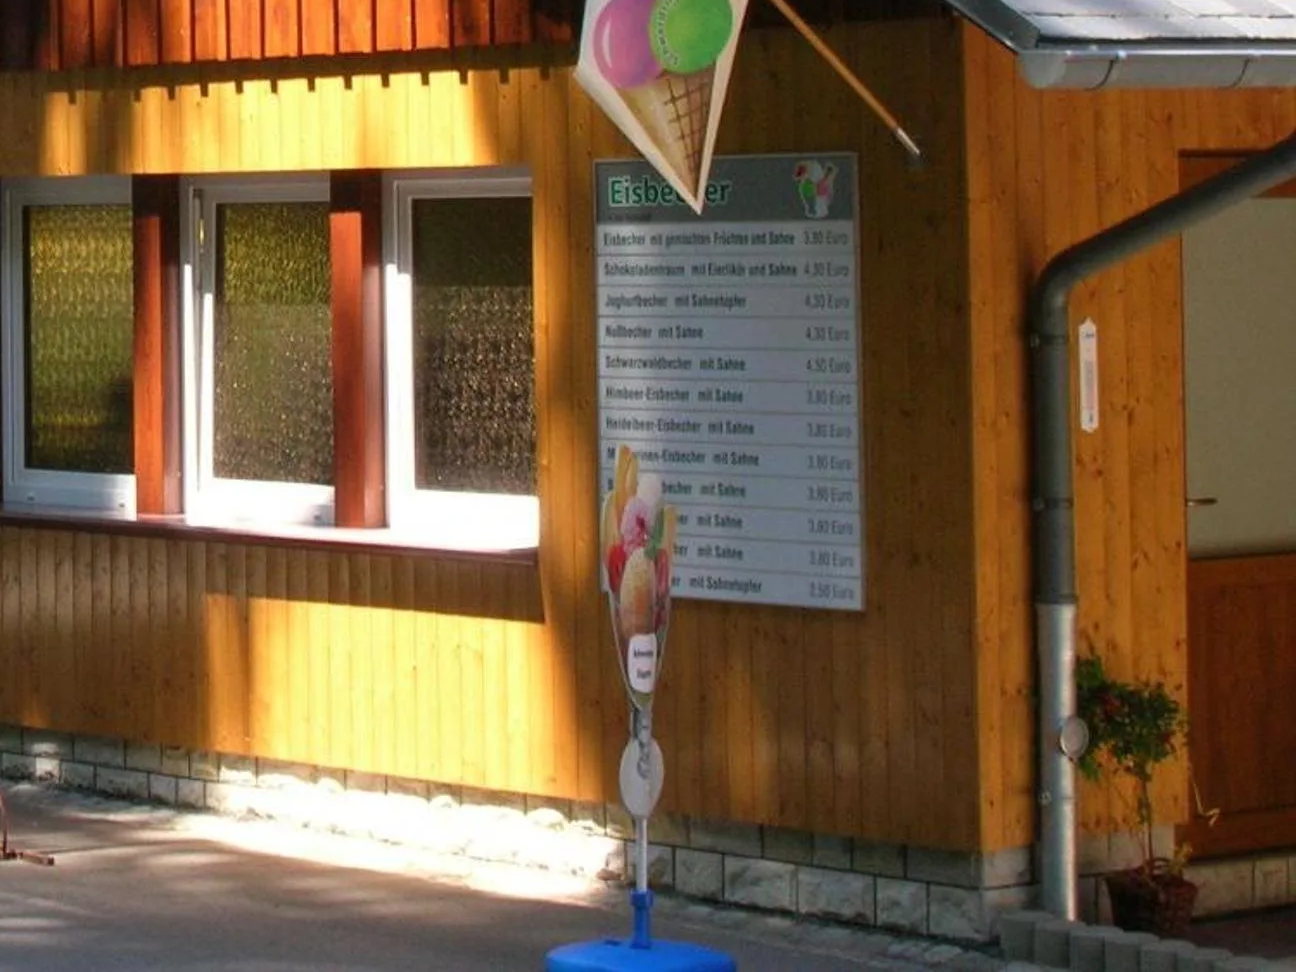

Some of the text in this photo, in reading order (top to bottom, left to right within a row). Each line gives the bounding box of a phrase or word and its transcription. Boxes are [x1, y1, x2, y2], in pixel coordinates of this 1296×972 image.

[769, 231, 795, 245] Sahne
[769, 263, 797, 277] Sahne
[717, 357, 746, 372] Sahne
[715, 389, 744, 404] Sahne
